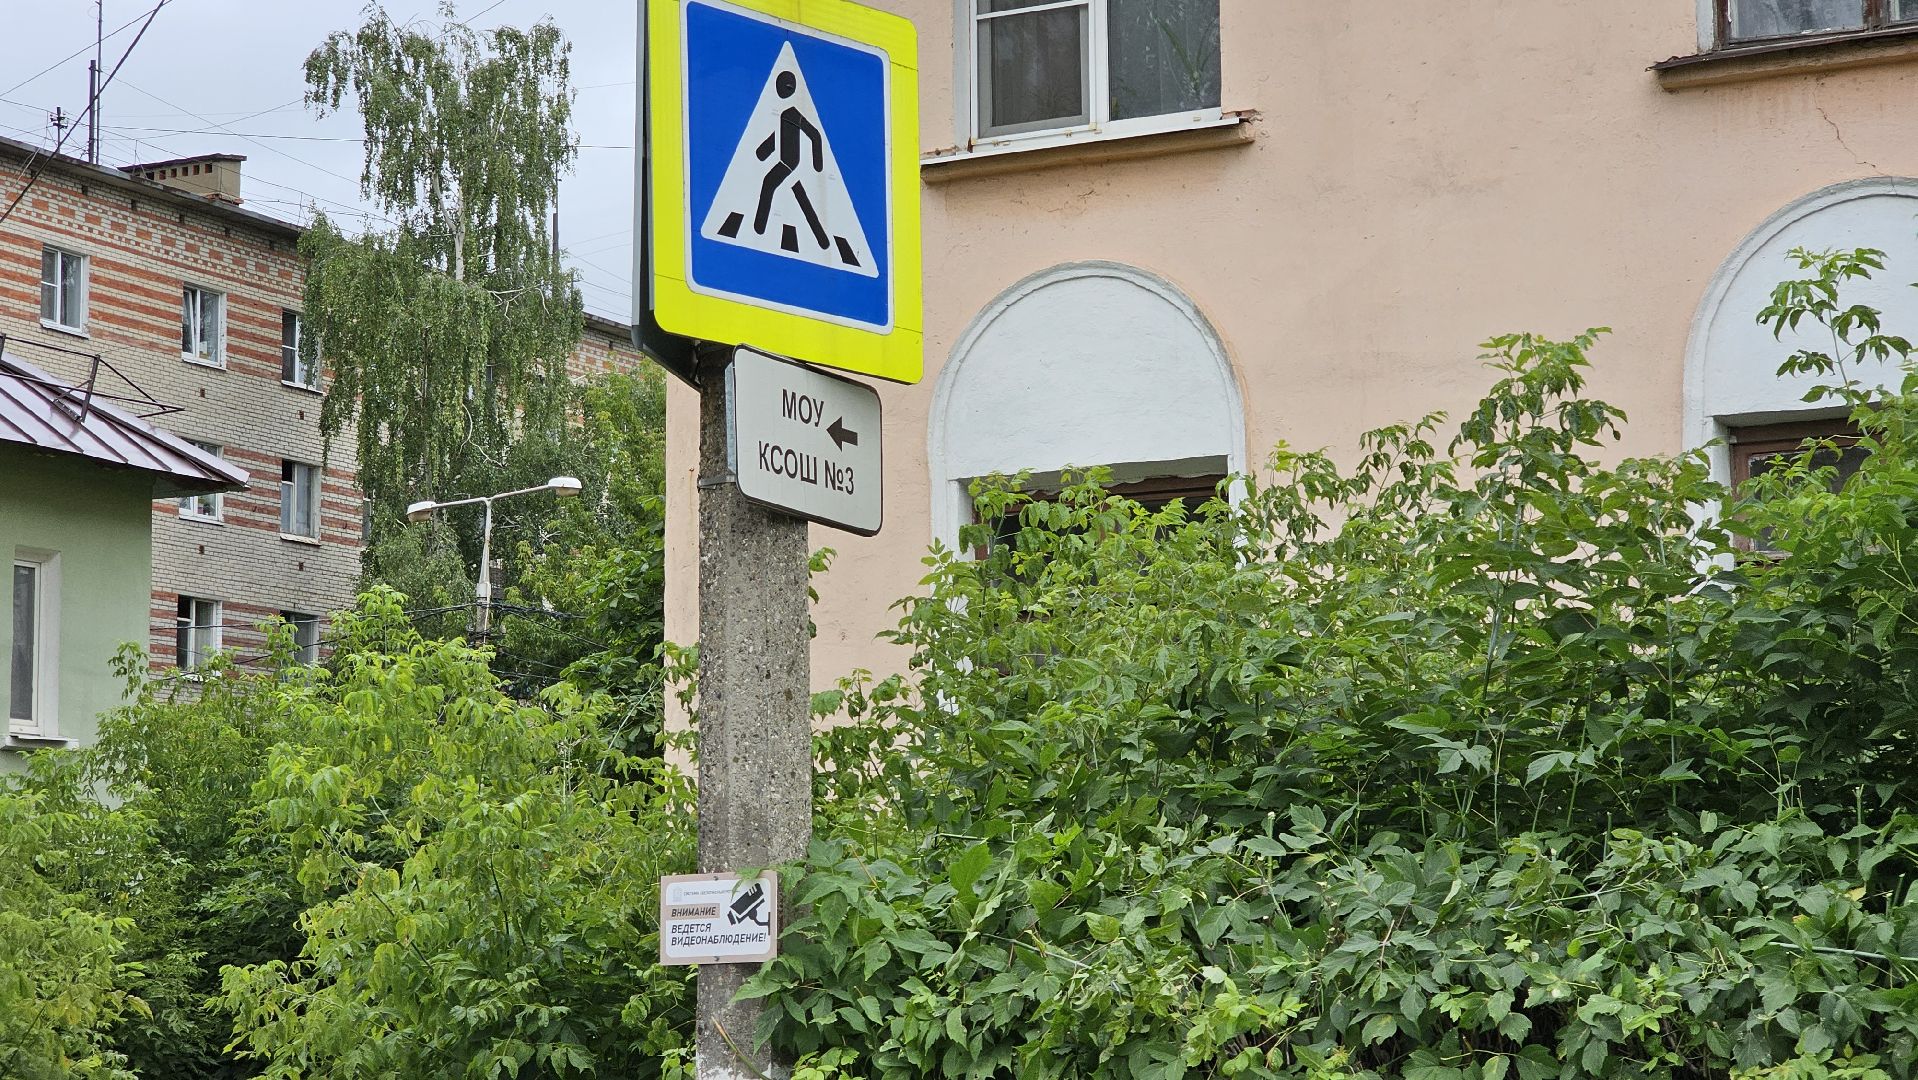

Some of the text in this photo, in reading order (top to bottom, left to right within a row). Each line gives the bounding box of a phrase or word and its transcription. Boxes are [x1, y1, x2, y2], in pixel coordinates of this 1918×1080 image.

[782, 388, 825, 427] МОУ
[758, 440, 855, 495] КСОШ №3
[671, 906, 717, 917] ВНИМАНИЕ
[671, 923, 712, 935] ВЕДЕТСЯ
[671, 933, 767, 947] ВИДЕОНАБЛЮДЕНИЕ!
